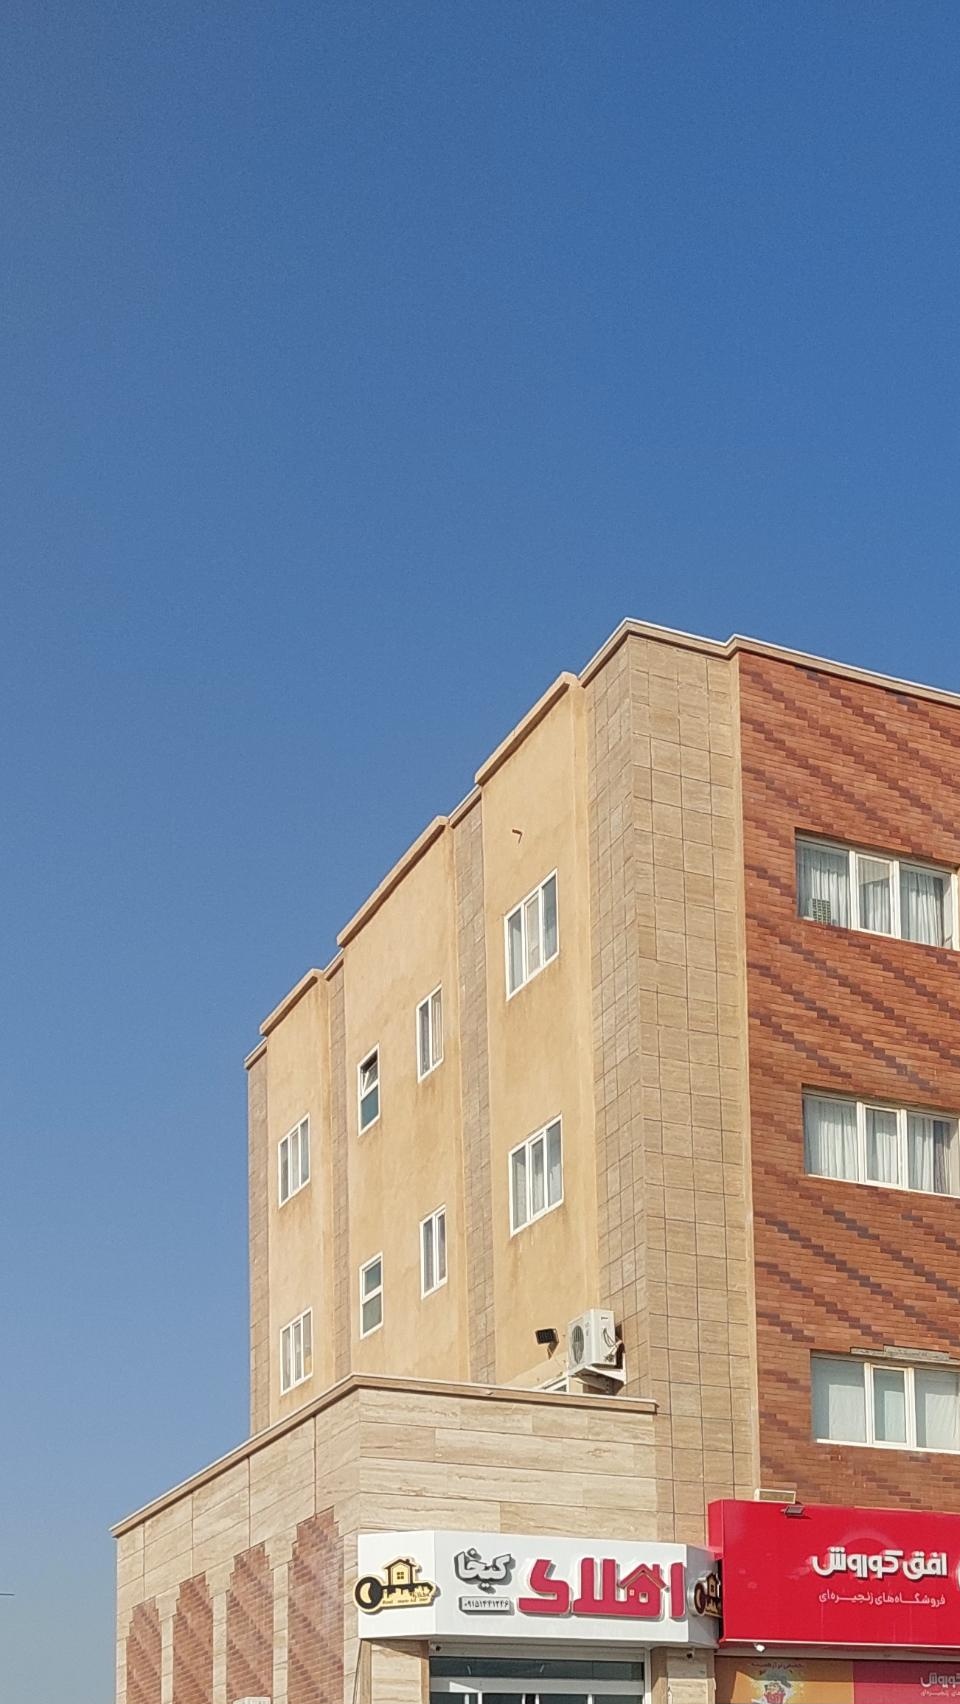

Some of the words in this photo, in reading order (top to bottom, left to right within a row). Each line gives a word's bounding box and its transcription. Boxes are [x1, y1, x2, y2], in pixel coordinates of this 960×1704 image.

[456, 1548, 513, 1590] کیخا
[811, 1546, 903, 1579] کوروش
[901, 1552, 948, 1581] افق
[518, 1557, 686, 1618] املاک
